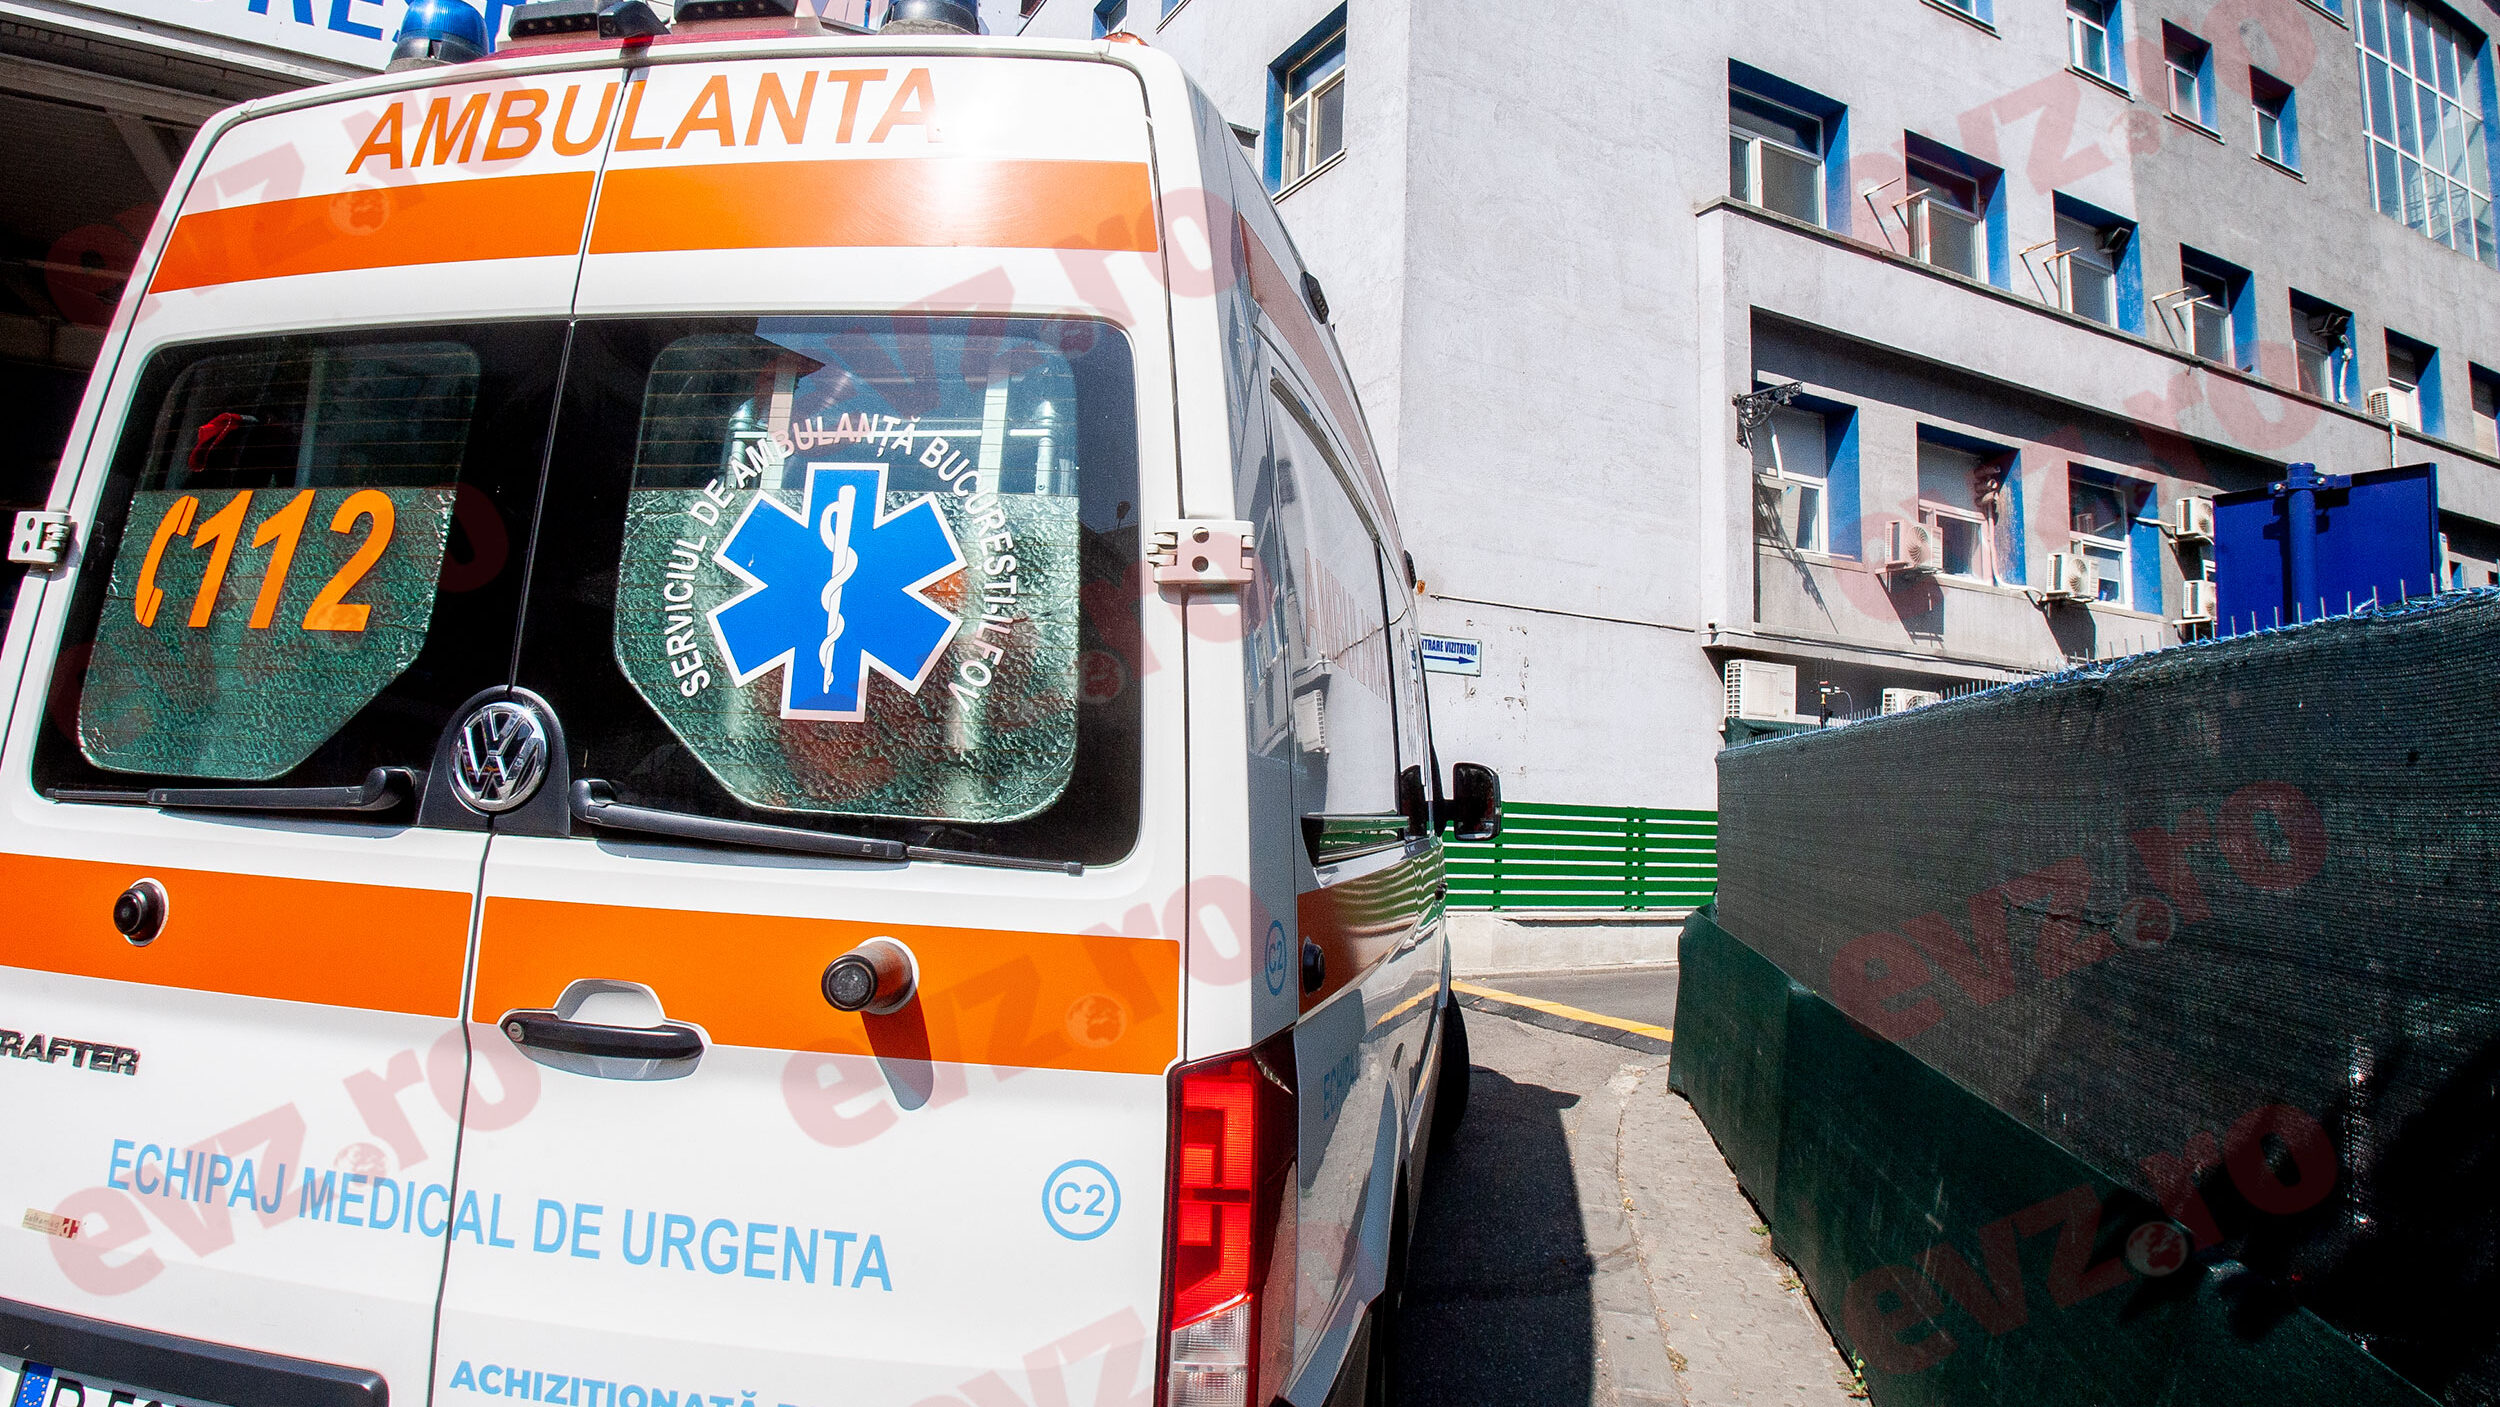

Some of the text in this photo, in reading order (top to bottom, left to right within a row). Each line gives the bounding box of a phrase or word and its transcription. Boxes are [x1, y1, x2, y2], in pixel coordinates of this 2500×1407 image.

[346, 67, 943, 174] AMBULANTA
[188, 489, 396, 632] 112
[663, 535, 709, 699] SERVICIUL
[691, 479, 735, 528] DE
[1444, 641, 1478, 656] VIZITATORI
[0, 1027, 140, 1076] RAFTER
[108, 1138, 893, 1291] ECHIPAJ MEDICAL DE URGENTA
[1054, 1181, 1106, 1217] C2
